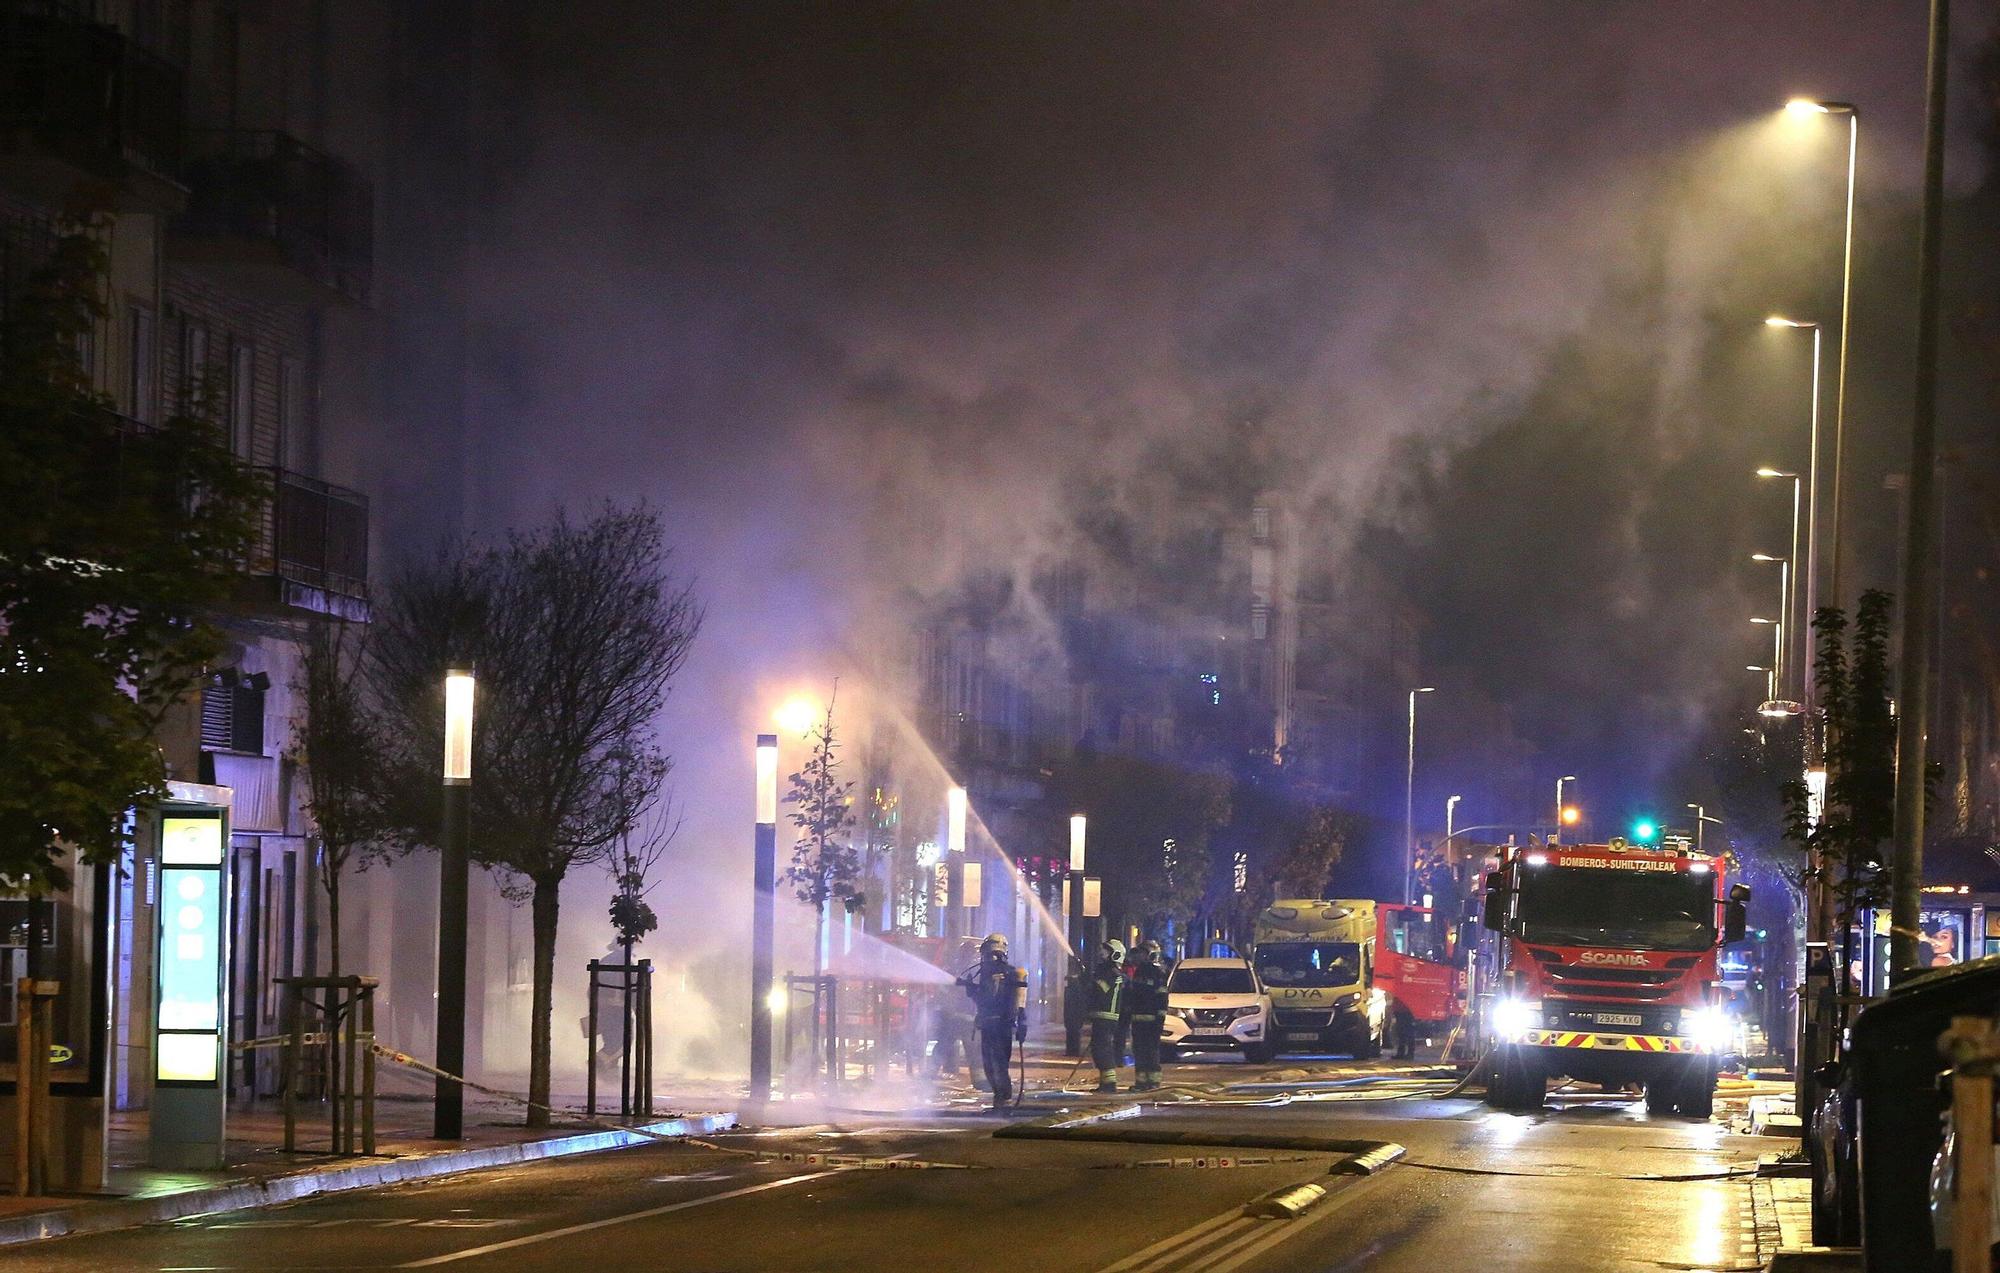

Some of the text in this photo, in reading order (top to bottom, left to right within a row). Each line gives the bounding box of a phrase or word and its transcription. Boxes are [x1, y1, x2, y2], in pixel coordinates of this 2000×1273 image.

[1560, 856, 1676, 872] BOMBEROS-SUHILTZAILEAK
[1580, 951, 1649, 966] SCANIA
[1810, 948, 1824, 968] P
[1284, 988, 1322, 999] DYA
[1599, 1014, 1640, 1025] 2925 KKG
